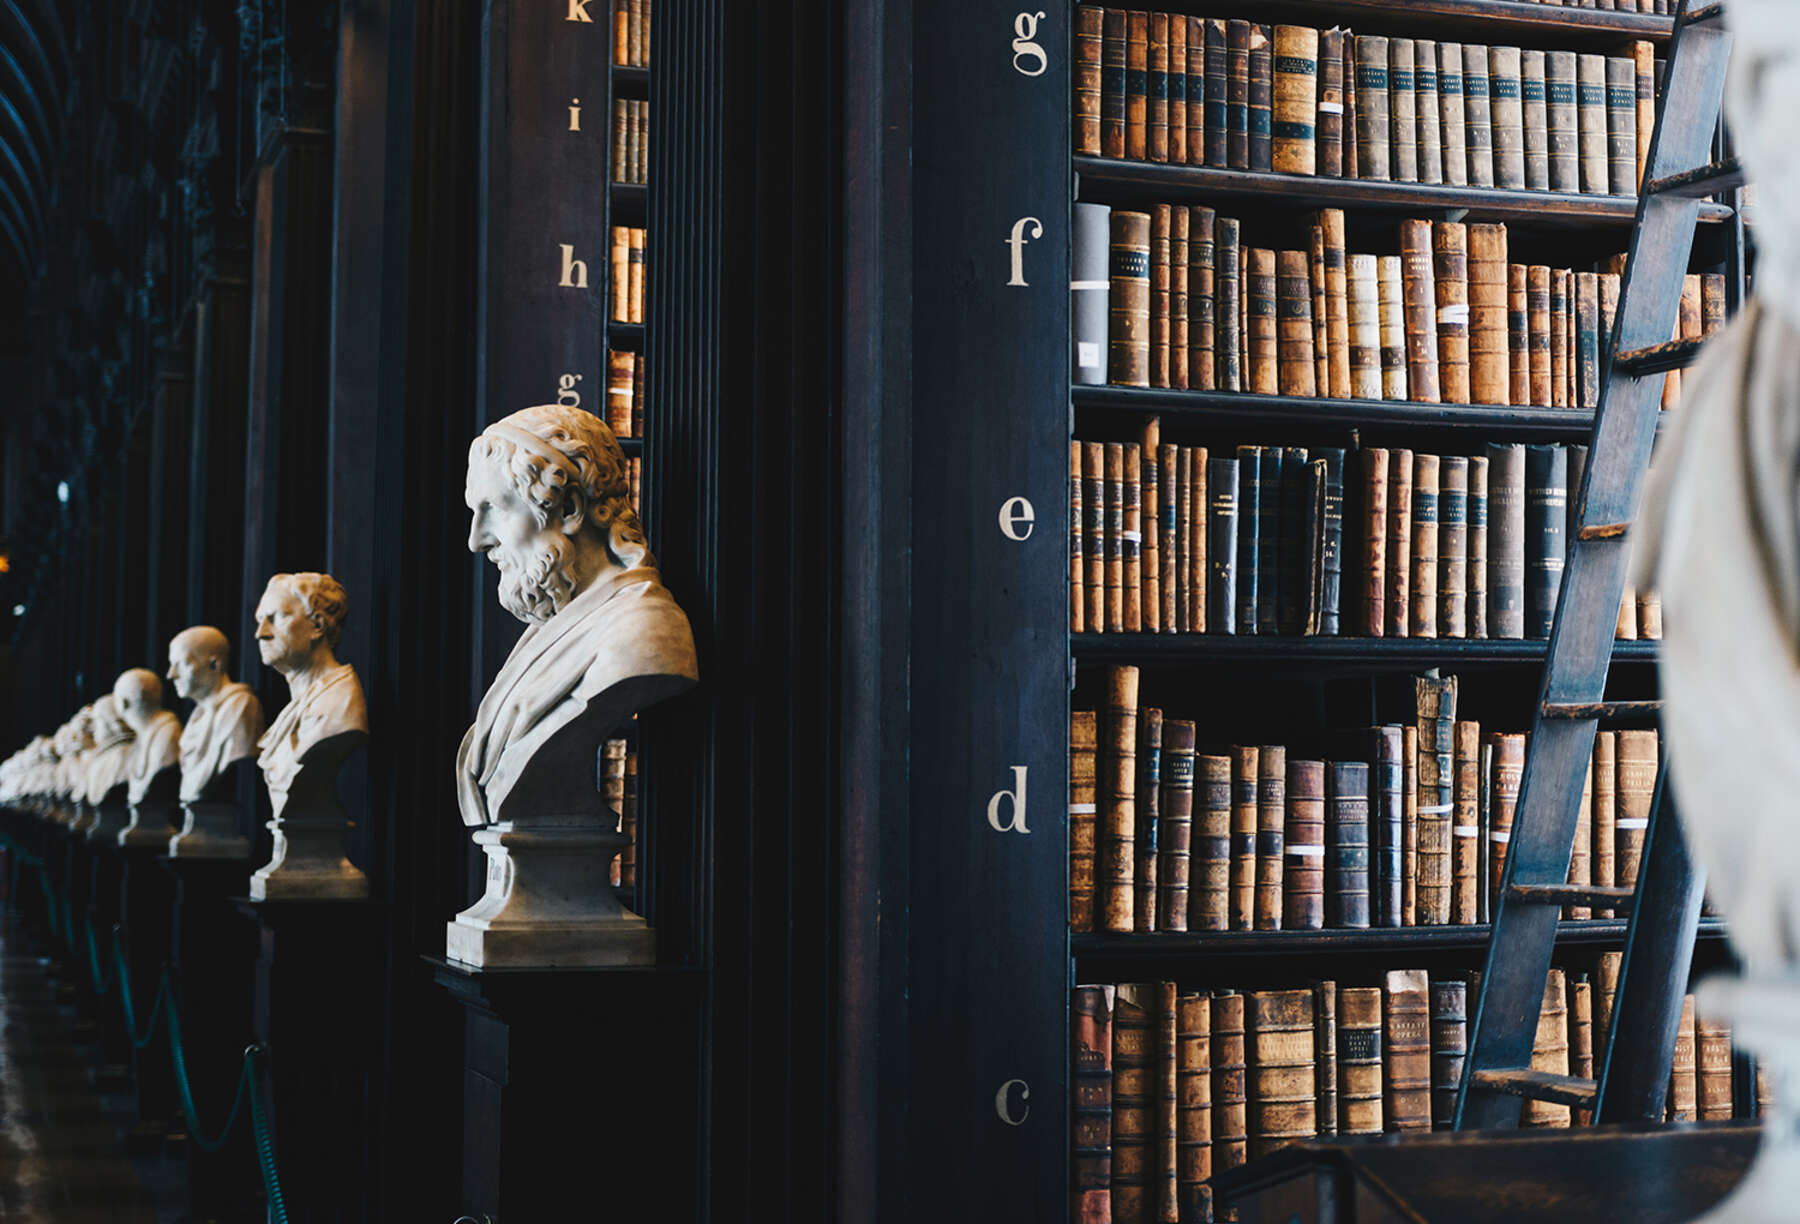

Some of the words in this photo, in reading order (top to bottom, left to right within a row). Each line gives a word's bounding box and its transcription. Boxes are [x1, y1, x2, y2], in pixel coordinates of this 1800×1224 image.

[1012, 10, 1048, 77] g
[568, 97, 582, 131] i
[557, 243, 589, 289] h
[1004, 216, 1043, 287] f
[557, 373, 583, 407] g
[998, 496, 1036, 542] e
[987, 765, 1032, 834] d
[996, 1079, 1030, 1124] c
